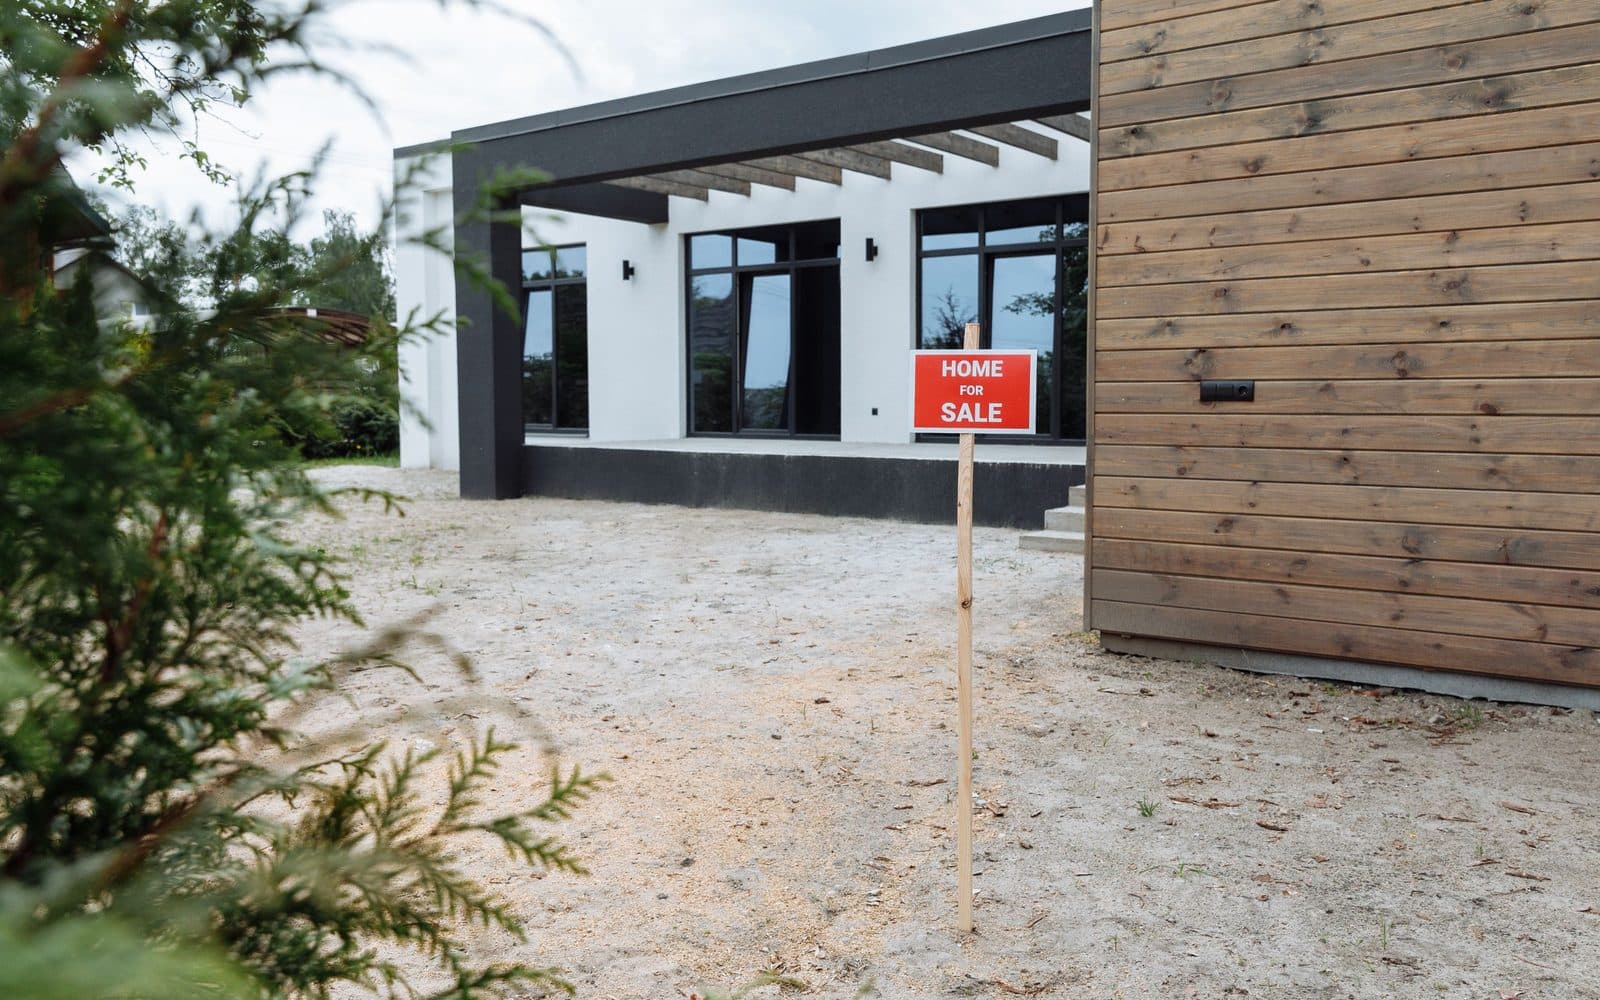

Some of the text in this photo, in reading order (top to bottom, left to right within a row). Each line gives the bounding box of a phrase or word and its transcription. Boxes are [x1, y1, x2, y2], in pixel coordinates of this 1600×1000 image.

[942, 359, 1004, 377] HOME
[959, 385, 984, 396] FOR
[941, 402, 1003, 422] SALE
